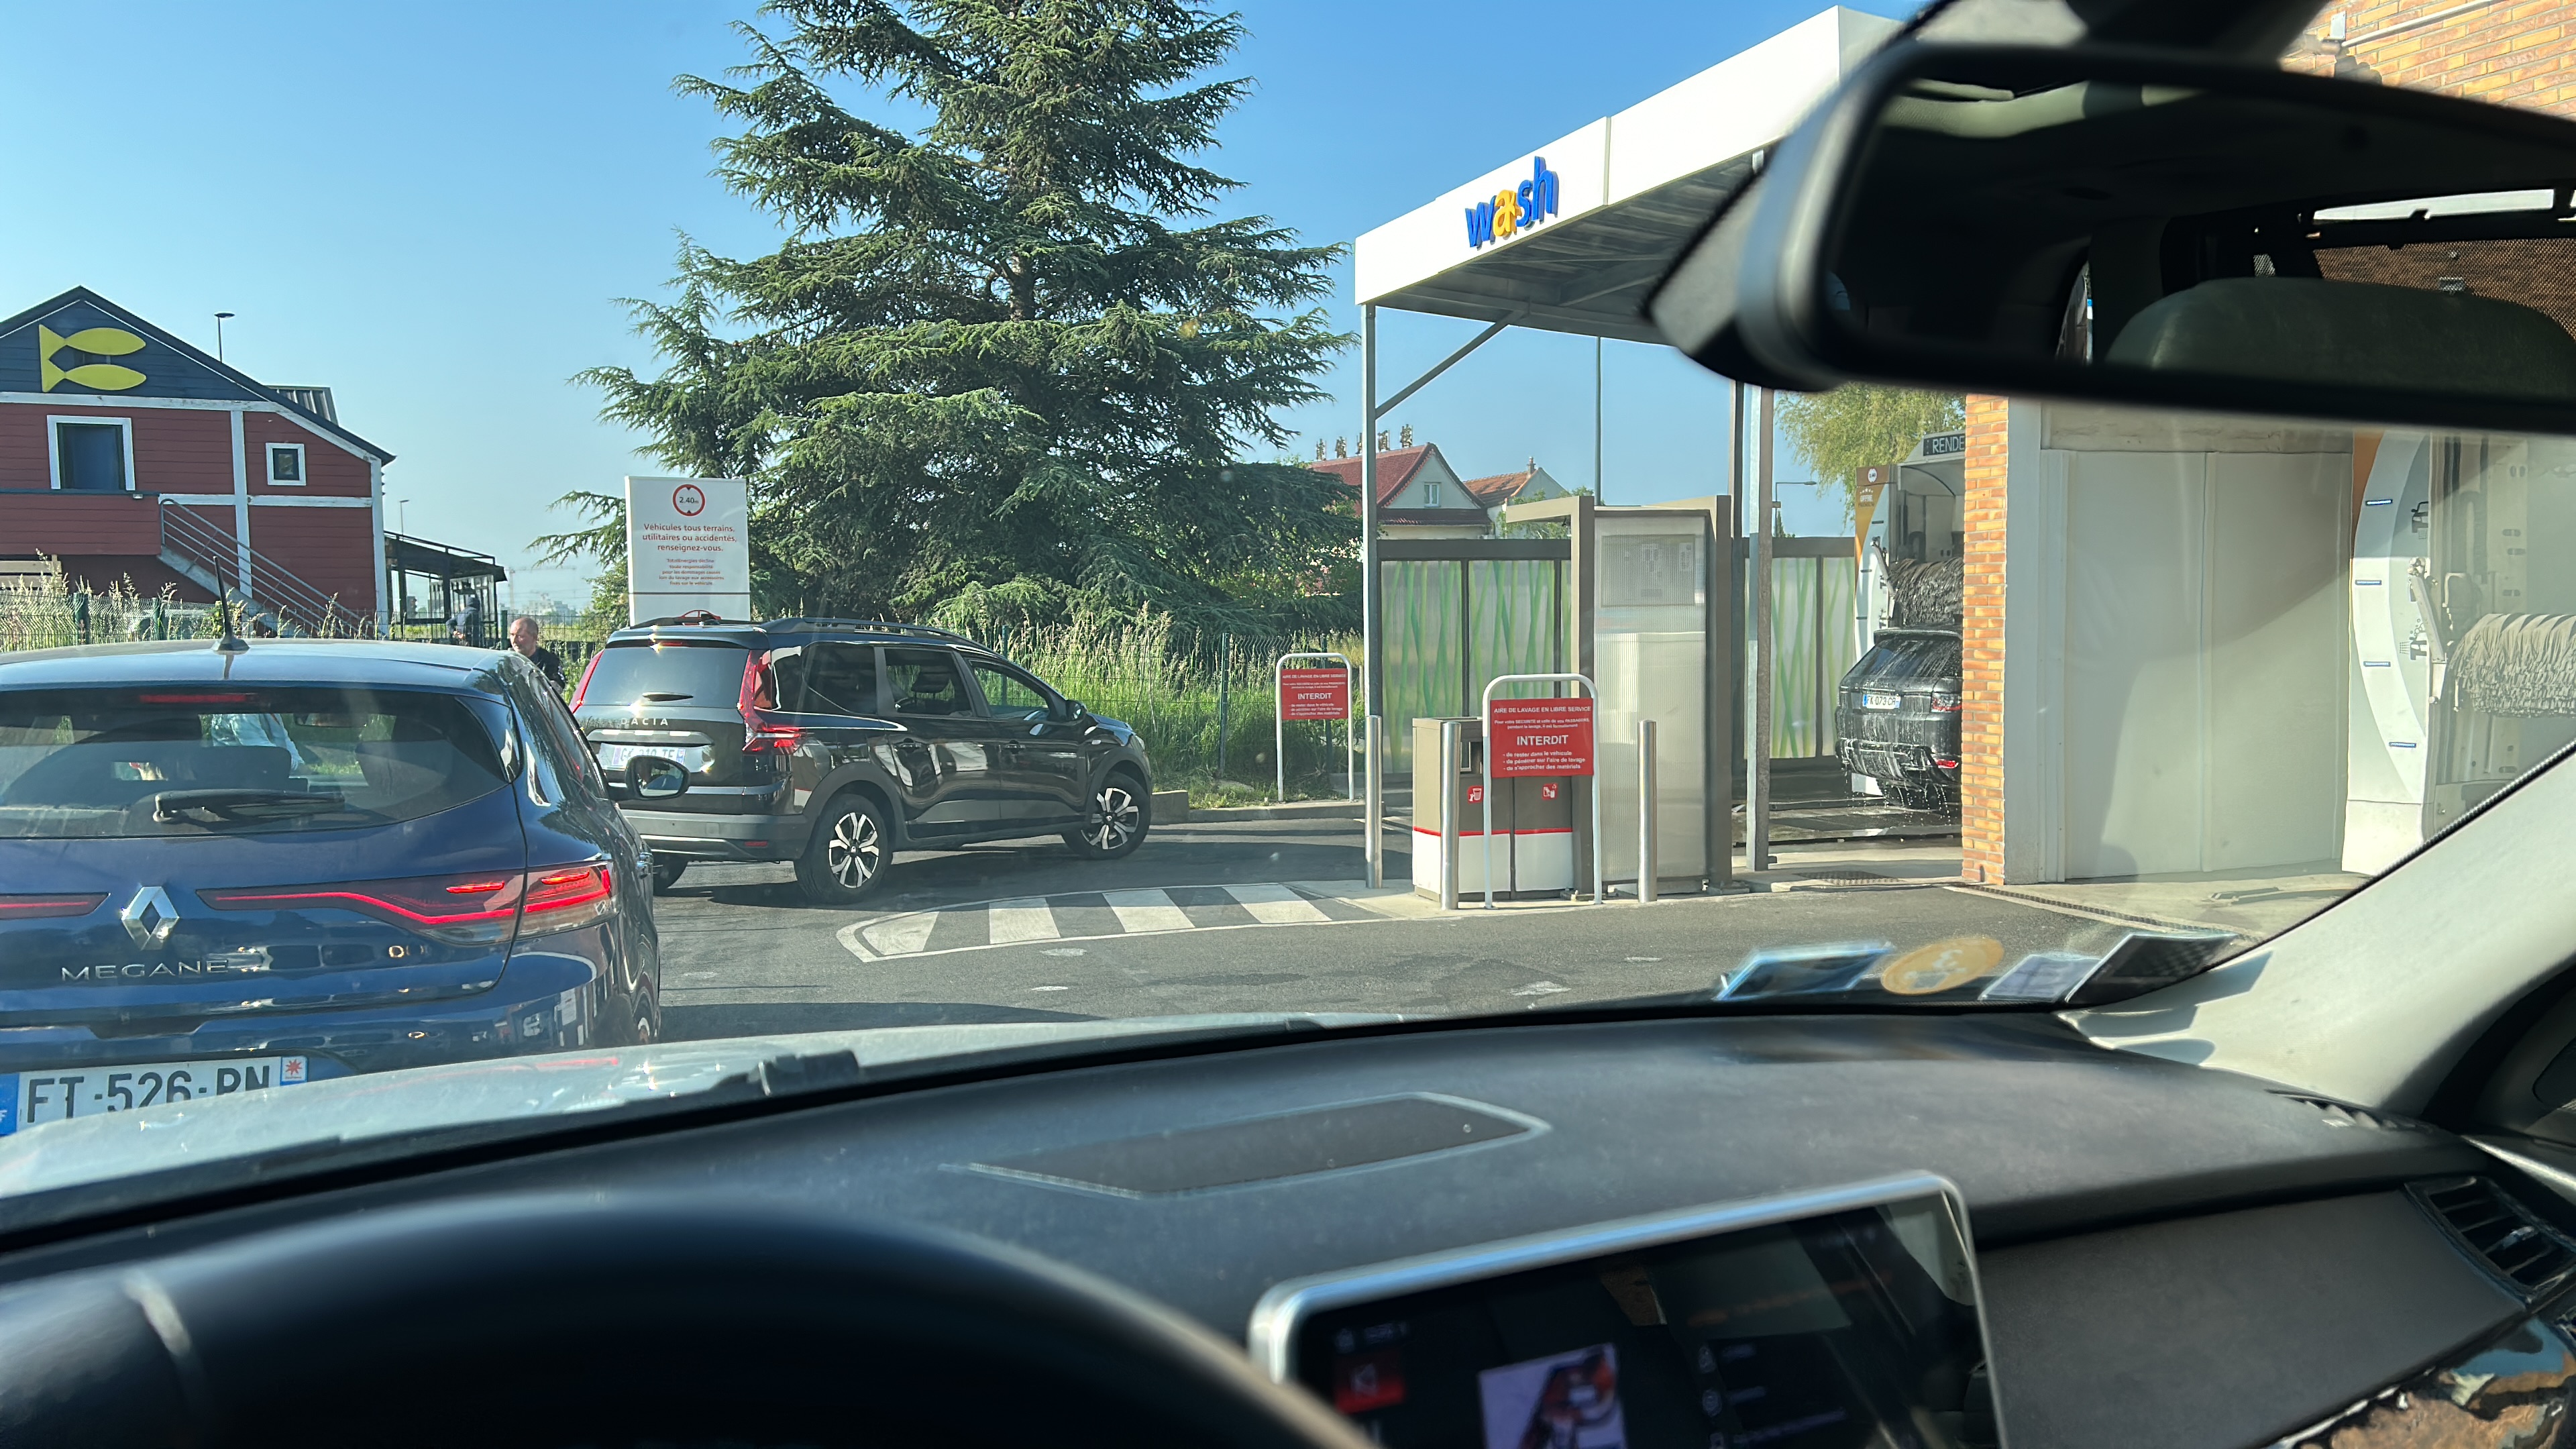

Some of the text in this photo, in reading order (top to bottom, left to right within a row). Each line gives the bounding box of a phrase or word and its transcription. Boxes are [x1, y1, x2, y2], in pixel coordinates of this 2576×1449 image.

[1465, 156, 1558, 249] wash
[1933, 435, 1965, 453] RENDE
[643, 523, 682, 531] Véhicules
[695, 535, 737, 543] accidentés,
[657, 543, 723, 552] renseignez-vous.
[1517, 735, 1569, 746] INTERDIT
[61, 960, 229, 982] MEGANE
